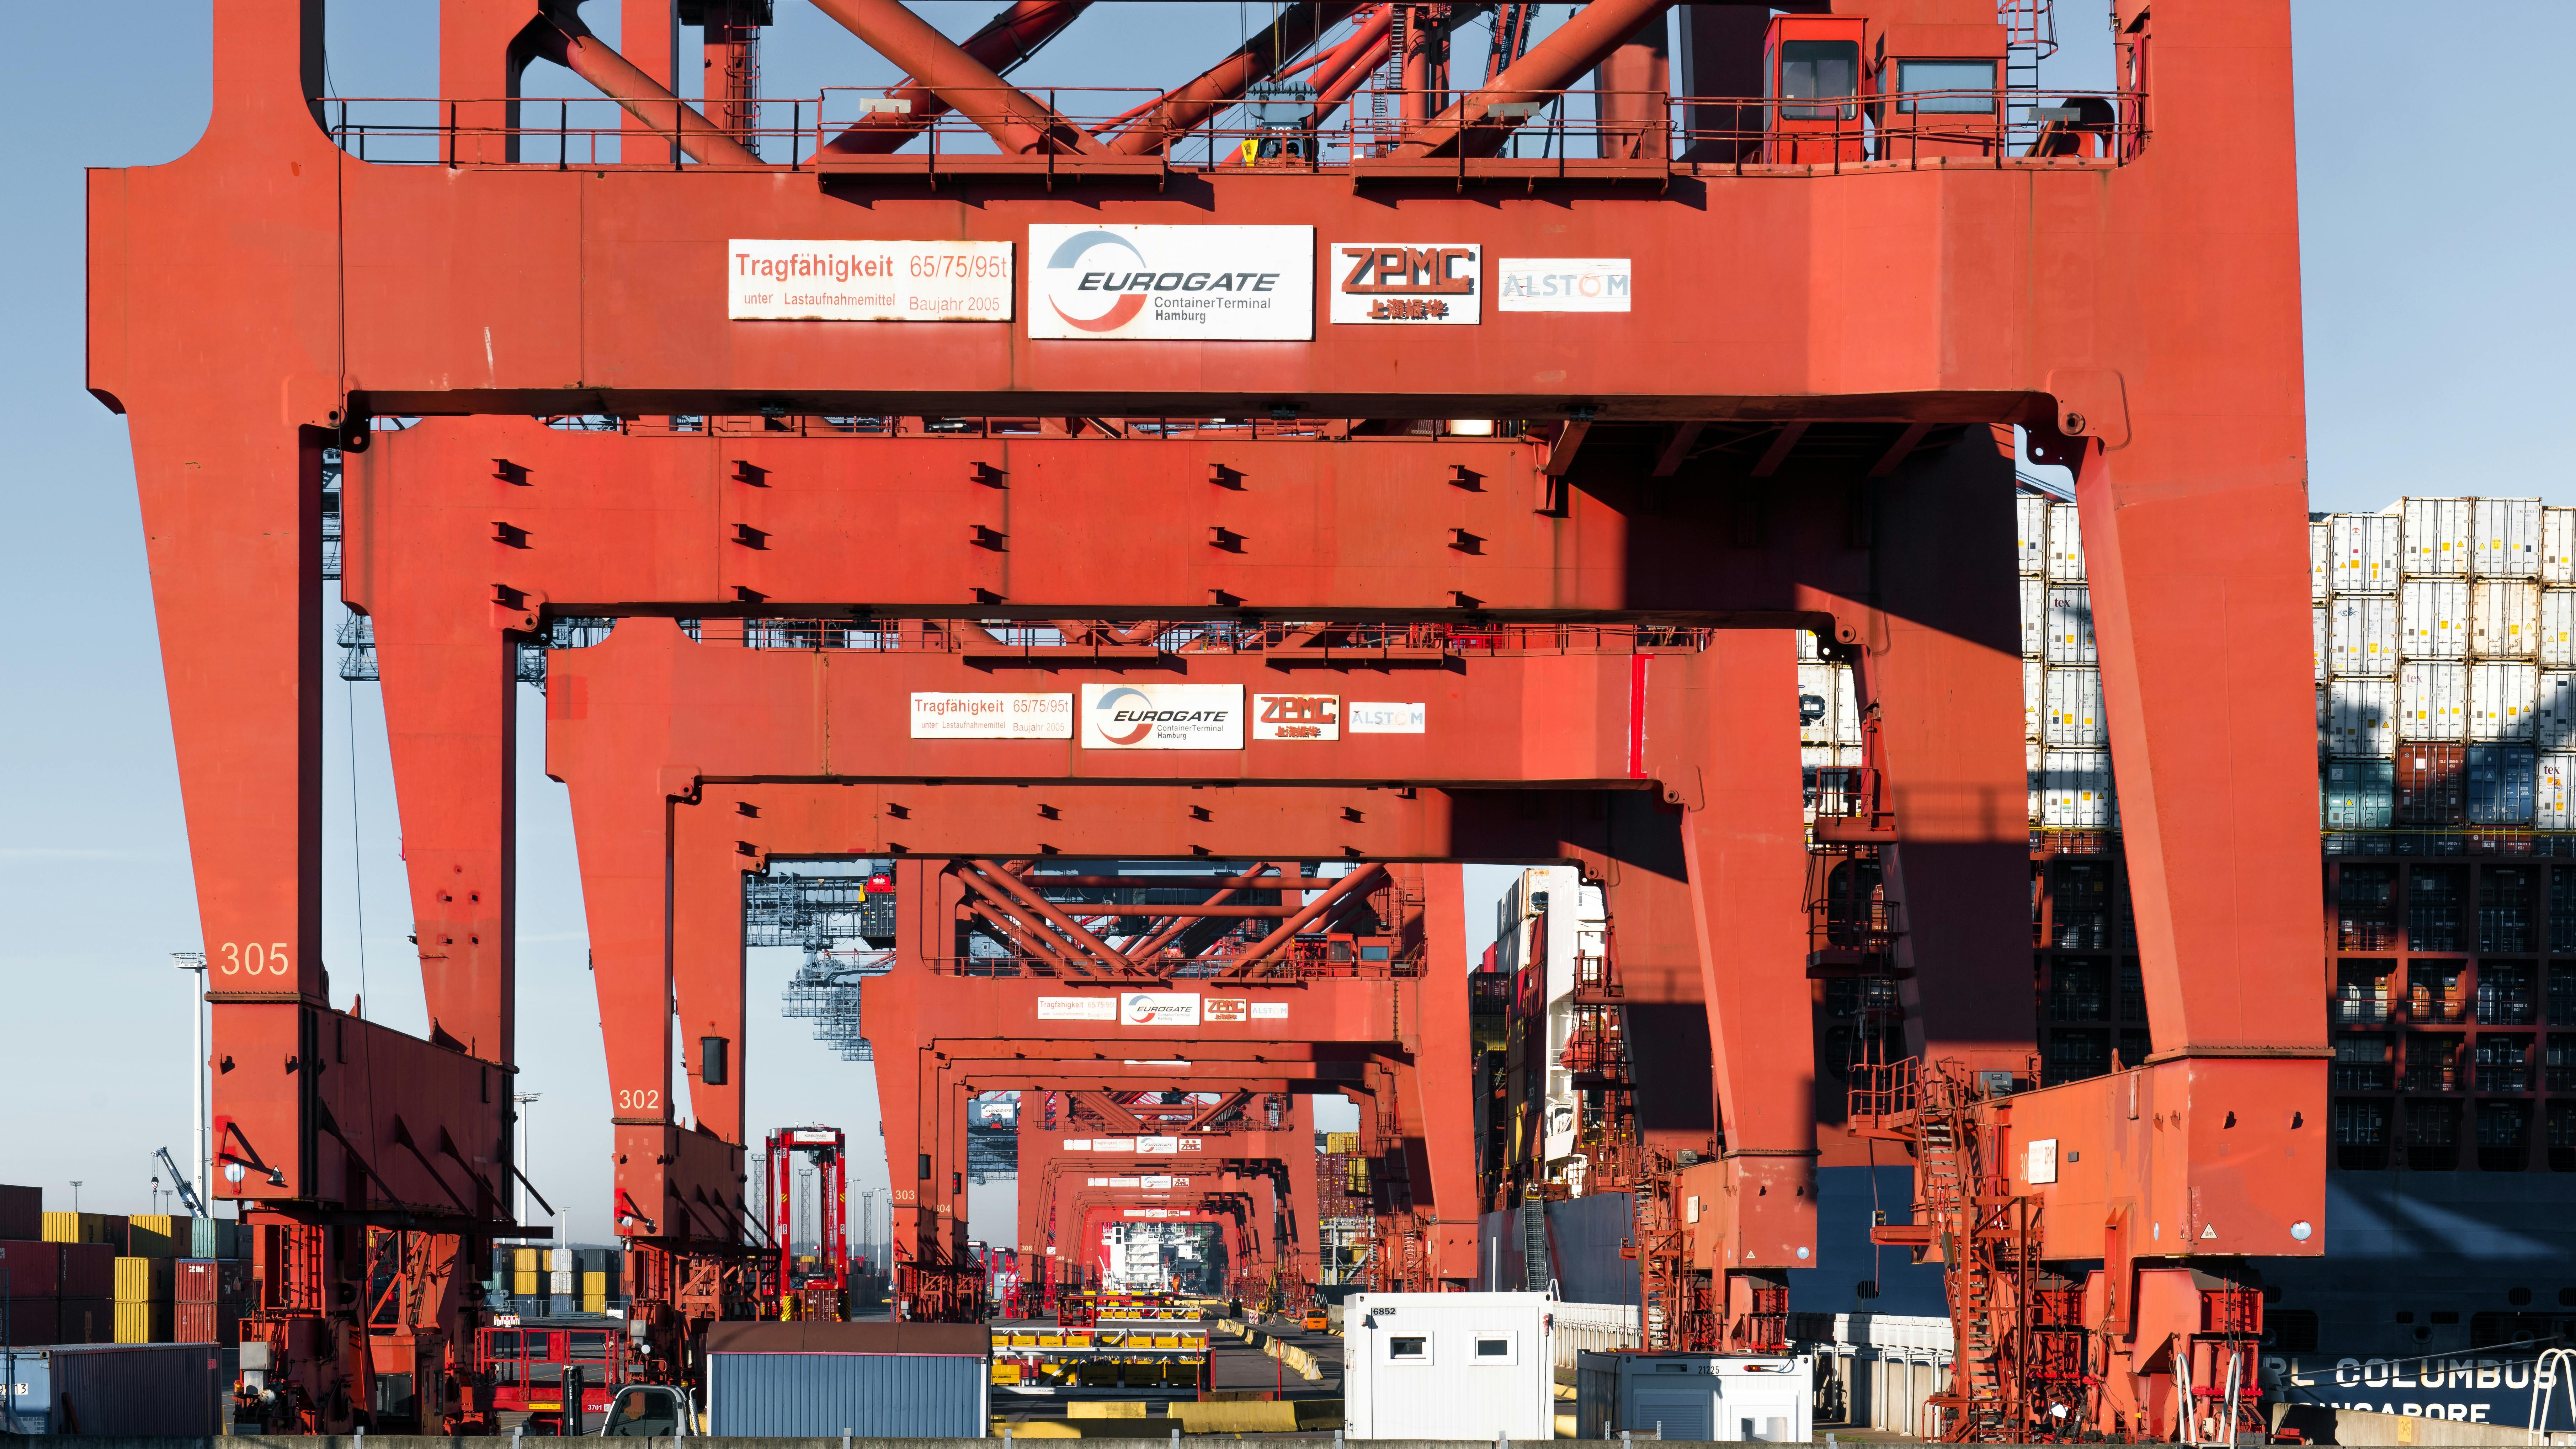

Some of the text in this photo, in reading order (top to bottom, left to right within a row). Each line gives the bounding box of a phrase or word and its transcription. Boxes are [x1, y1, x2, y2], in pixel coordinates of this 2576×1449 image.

[735, 254, 1007, 282] Tragfähigkeit 65/75/95t
[1341, 247, 1470, 293] ZPMC
[1077, 272, 1281, 292] EUROGATE
[1502, 272, 1628, 298] ALSTOM
[744, 292, 895, 306] unter Lastaufnahmemittel
[909, 296, 1000, 314] Baujahr 2005
[1366, 299, 1445, 318] 上海振华
[1155, 309, 1206, 324] Hamburg
[2054, 598, 2071, 608] tex
[2406, 673, 2423, 683] tex
[915, 699, 1069, 715] Tragfähigkeit 65/75/95t
[1260, 697, 1335, 723] ZPMC
[1113, 711, 1229, 722] EUROGATE
[1351, 711, 1423, 725] ALSTOM
[1013, 723, 1065, 733] Baujahr 2005
[2544, 765, 2560, 774] tex
[221, 942, 288, 975] 305
[1208, 1000, 1244, 1013] ZPMC
[619, 1090, 659, 1109] 302
[2020, 1153, 2028, 1181] 30
[895, 1190, 915, 1200] 303
[1698, 1366, 1719, 1374] 21225
[2336, 1357, 2558, 1389] COLUMBUS
[2399, 1421, 2411, 1436] 1345
